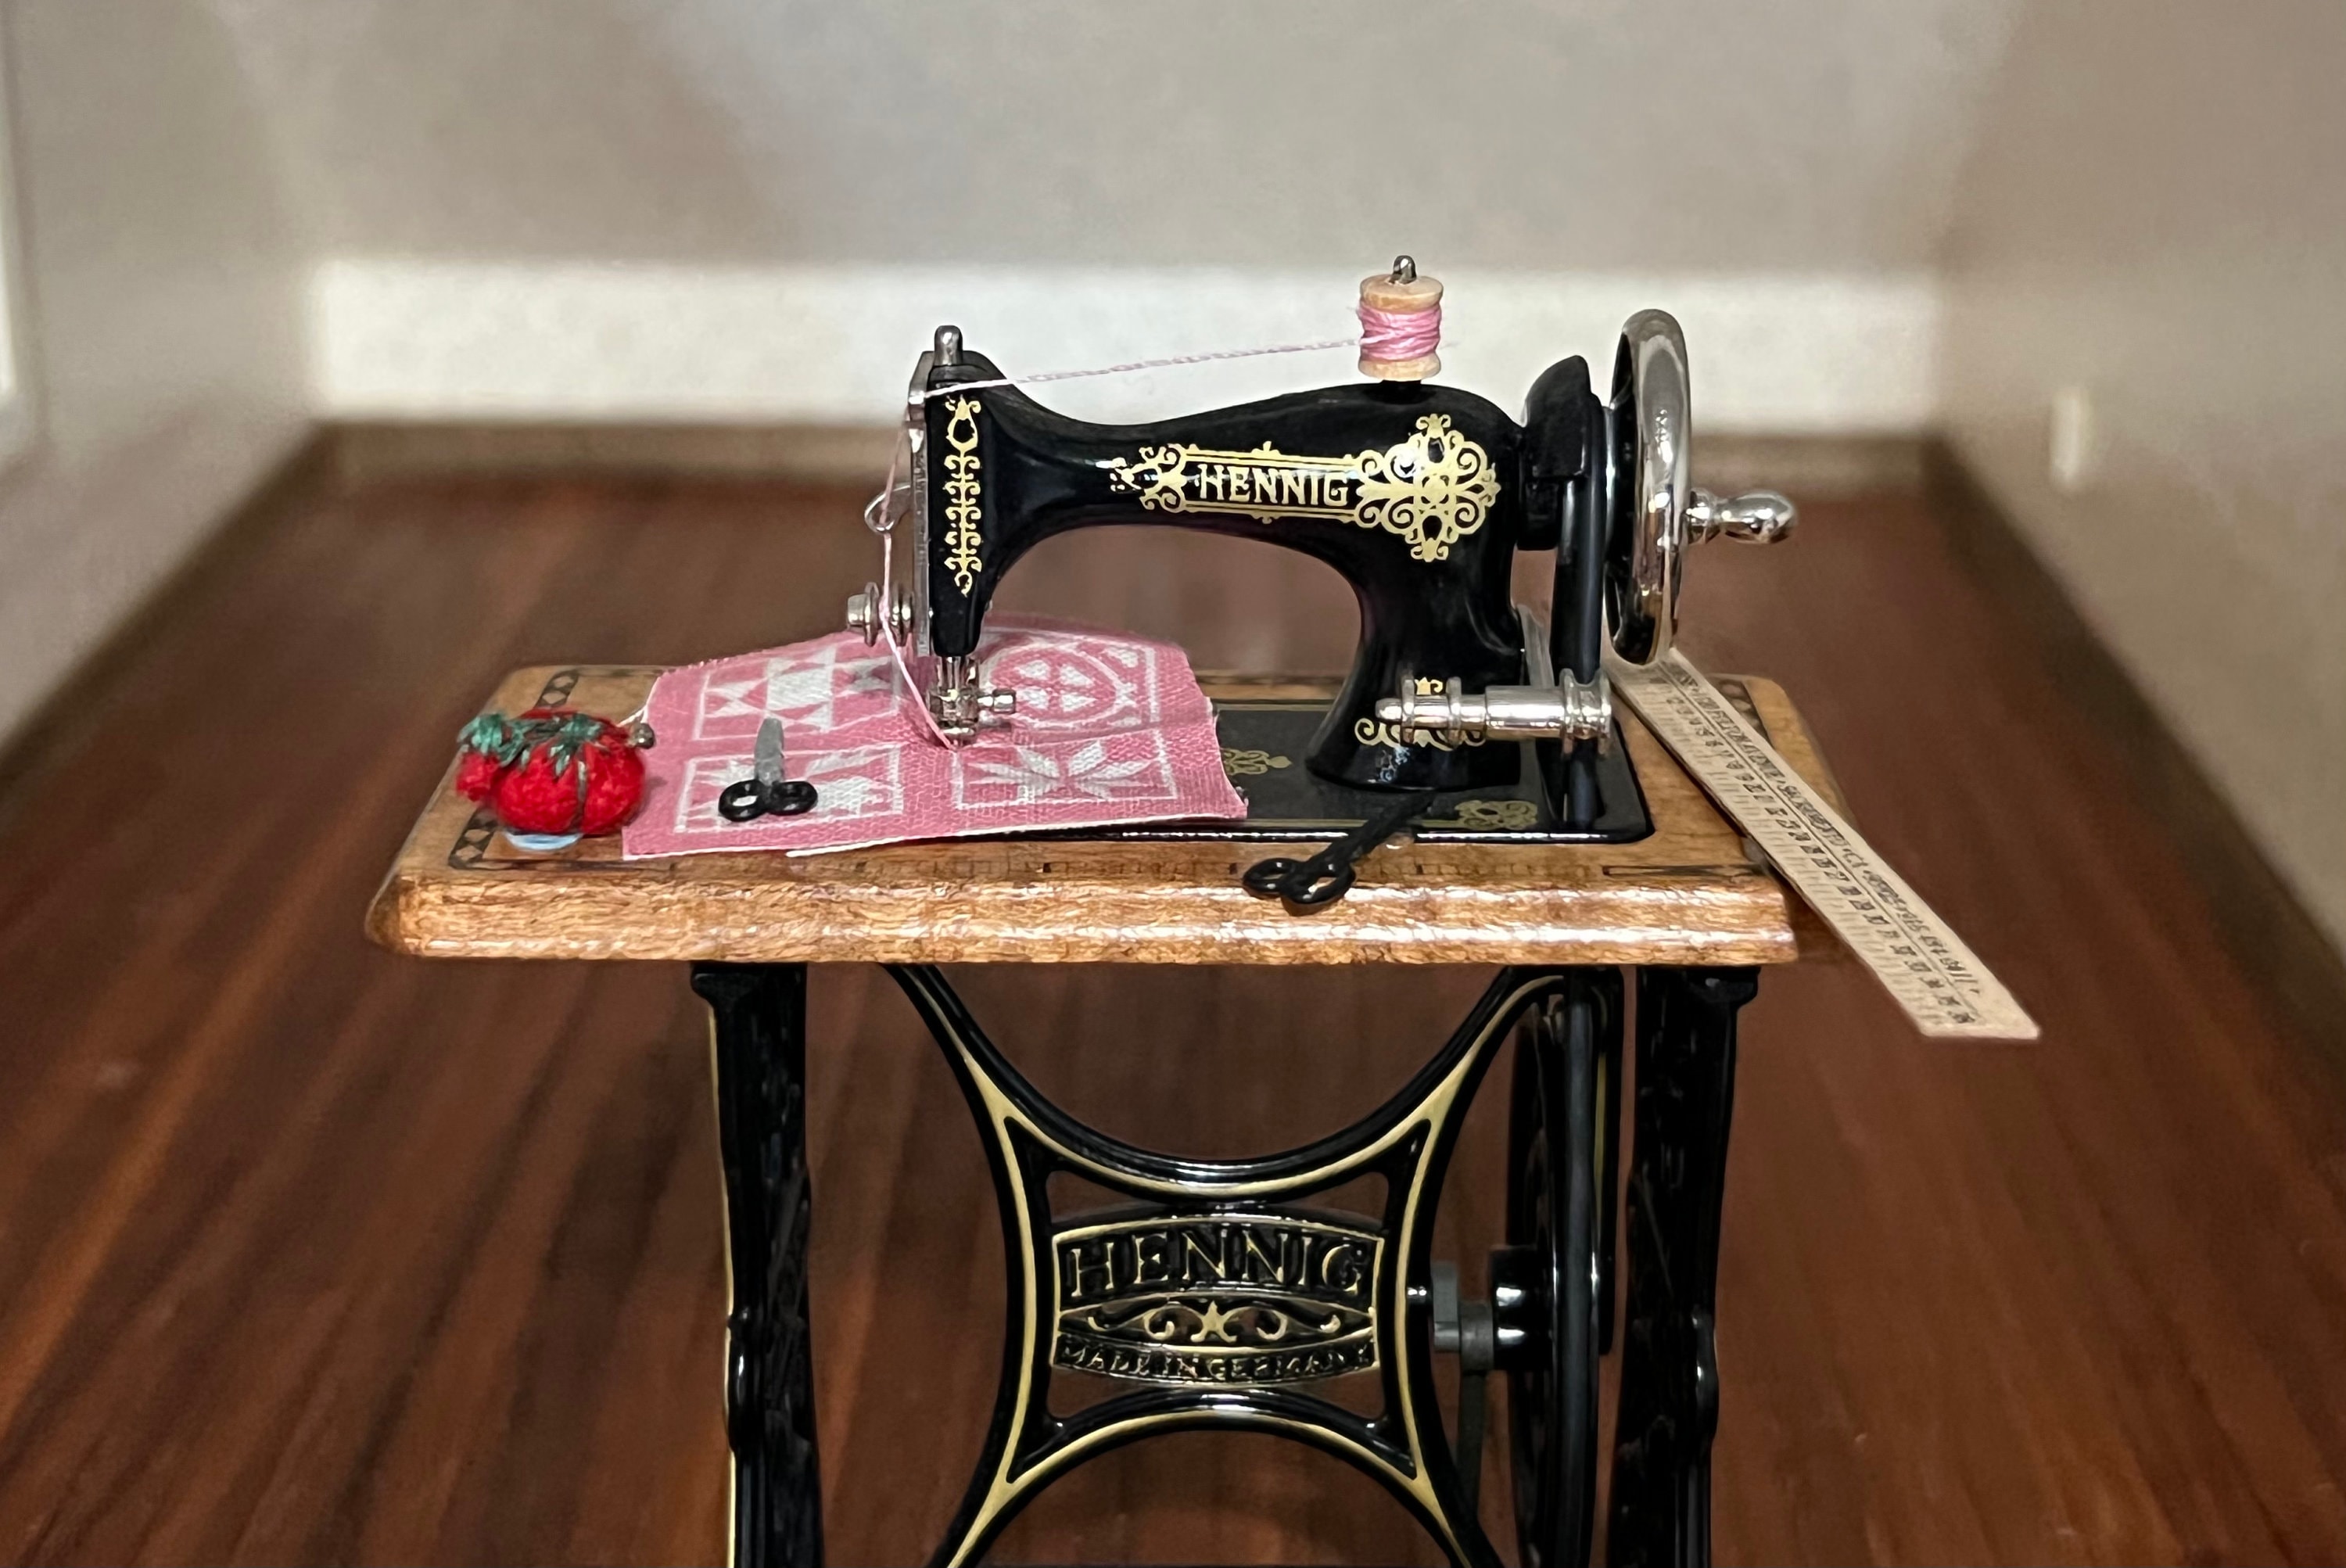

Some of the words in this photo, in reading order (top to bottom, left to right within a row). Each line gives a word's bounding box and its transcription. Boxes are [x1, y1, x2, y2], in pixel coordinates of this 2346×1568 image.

[1196, 464, 1349, 507] HENNIG
[1069, 1229, 1364, 1299] HENNIG
[1160, 1352, 1199, 1379] IN
